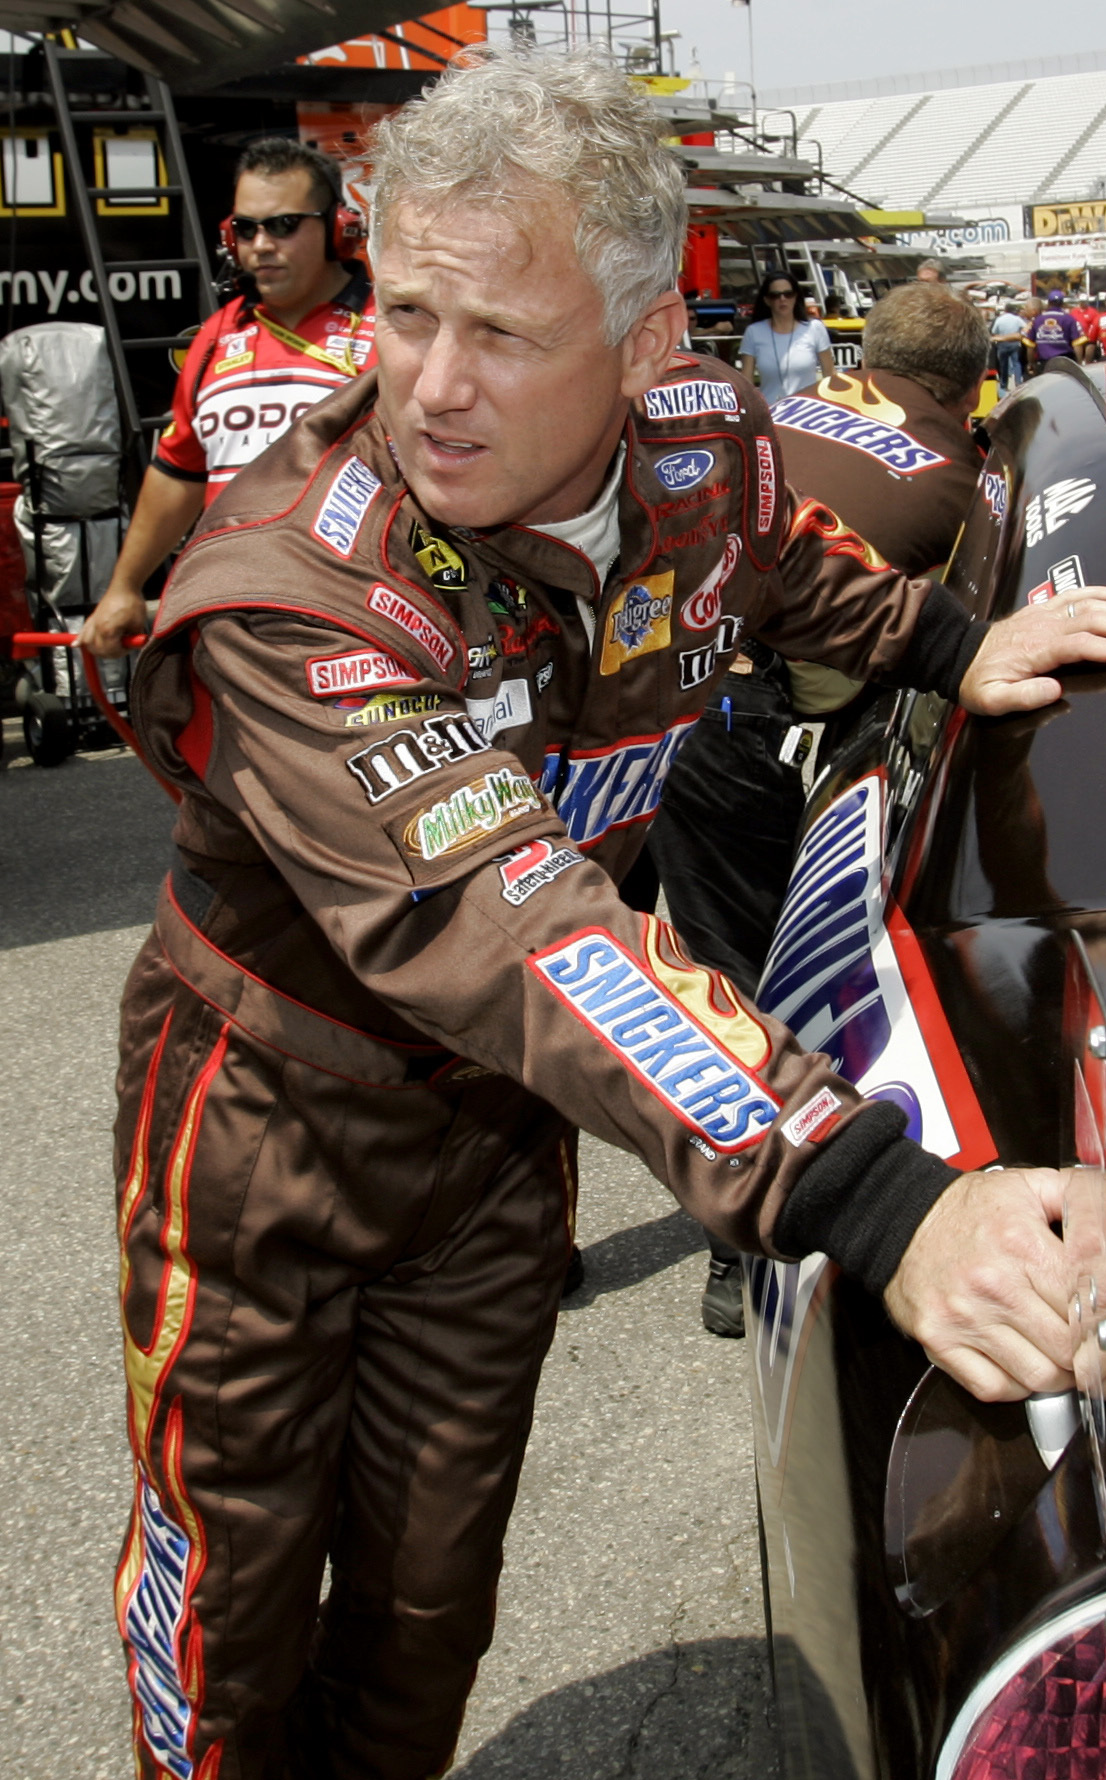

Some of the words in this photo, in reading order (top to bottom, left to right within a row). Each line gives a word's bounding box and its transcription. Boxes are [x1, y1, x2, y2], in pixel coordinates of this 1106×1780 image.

[648, 383, 737, 418] SNICKERS
[772, 397, 946, 472] SNICKERS
[660, 457, 701, 486] Ford
[758, 442, 774, 529] SIMPSON
[1025, 494, 1044, 548] TOOLS
[376, 591, 452, 669] SIMPSON
[421, 788, 500, 858] Milky
[547, 941, 780, 1142] SNICKERS
[793, 1096, 830, 1135] SIMPSON
